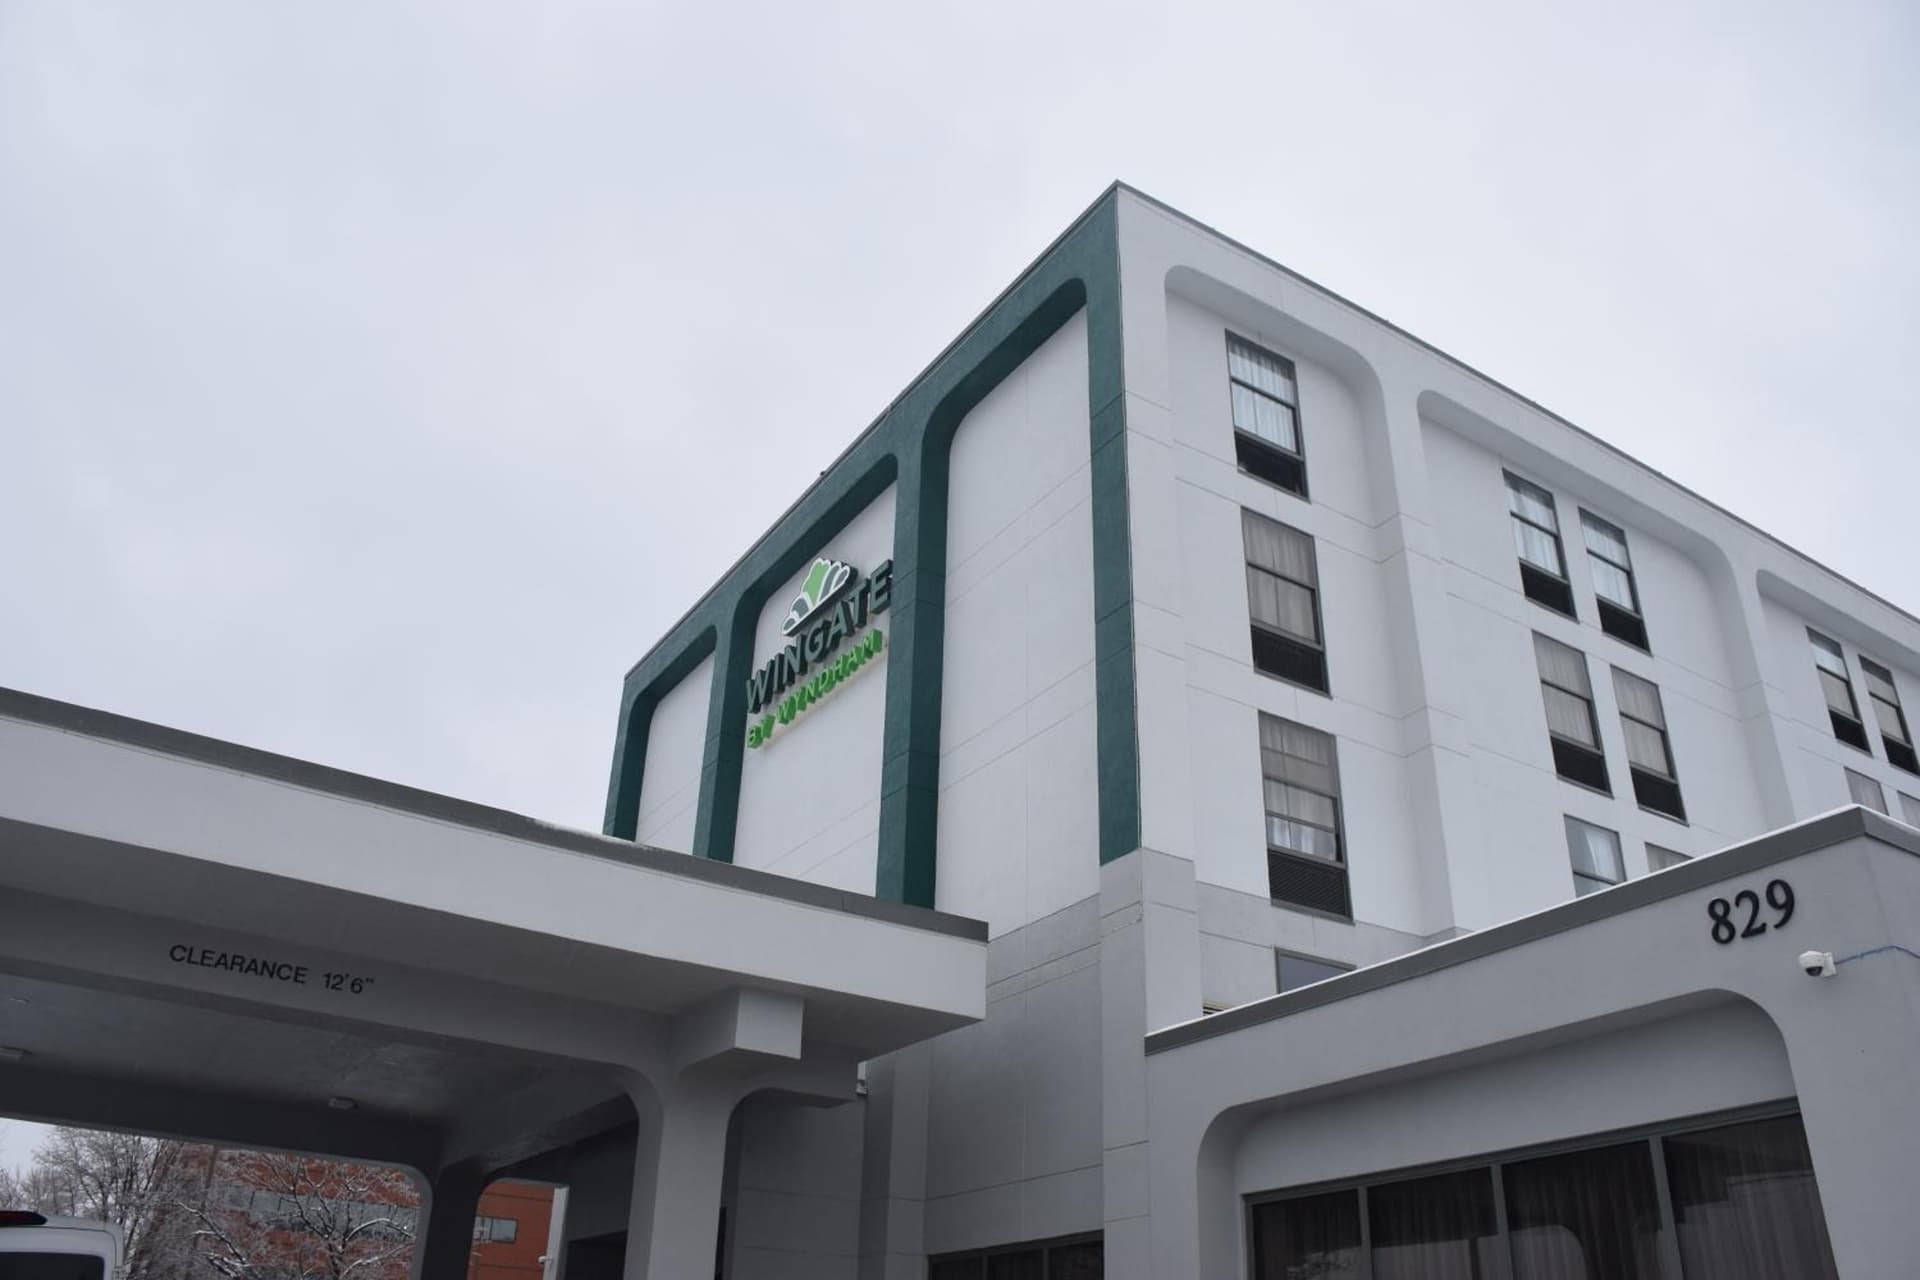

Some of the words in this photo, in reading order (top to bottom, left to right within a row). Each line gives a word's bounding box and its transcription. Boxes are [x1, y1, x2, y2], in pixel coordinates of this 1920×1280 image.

[746, 559, 893, 714] WINGATE
[747, 715, 775, 749] BY
[777, 628, 883, 725] WYNDHAM
[1708, 879, 1795, 944] 829
[169, 945, 308, 984] CLEARANCE
